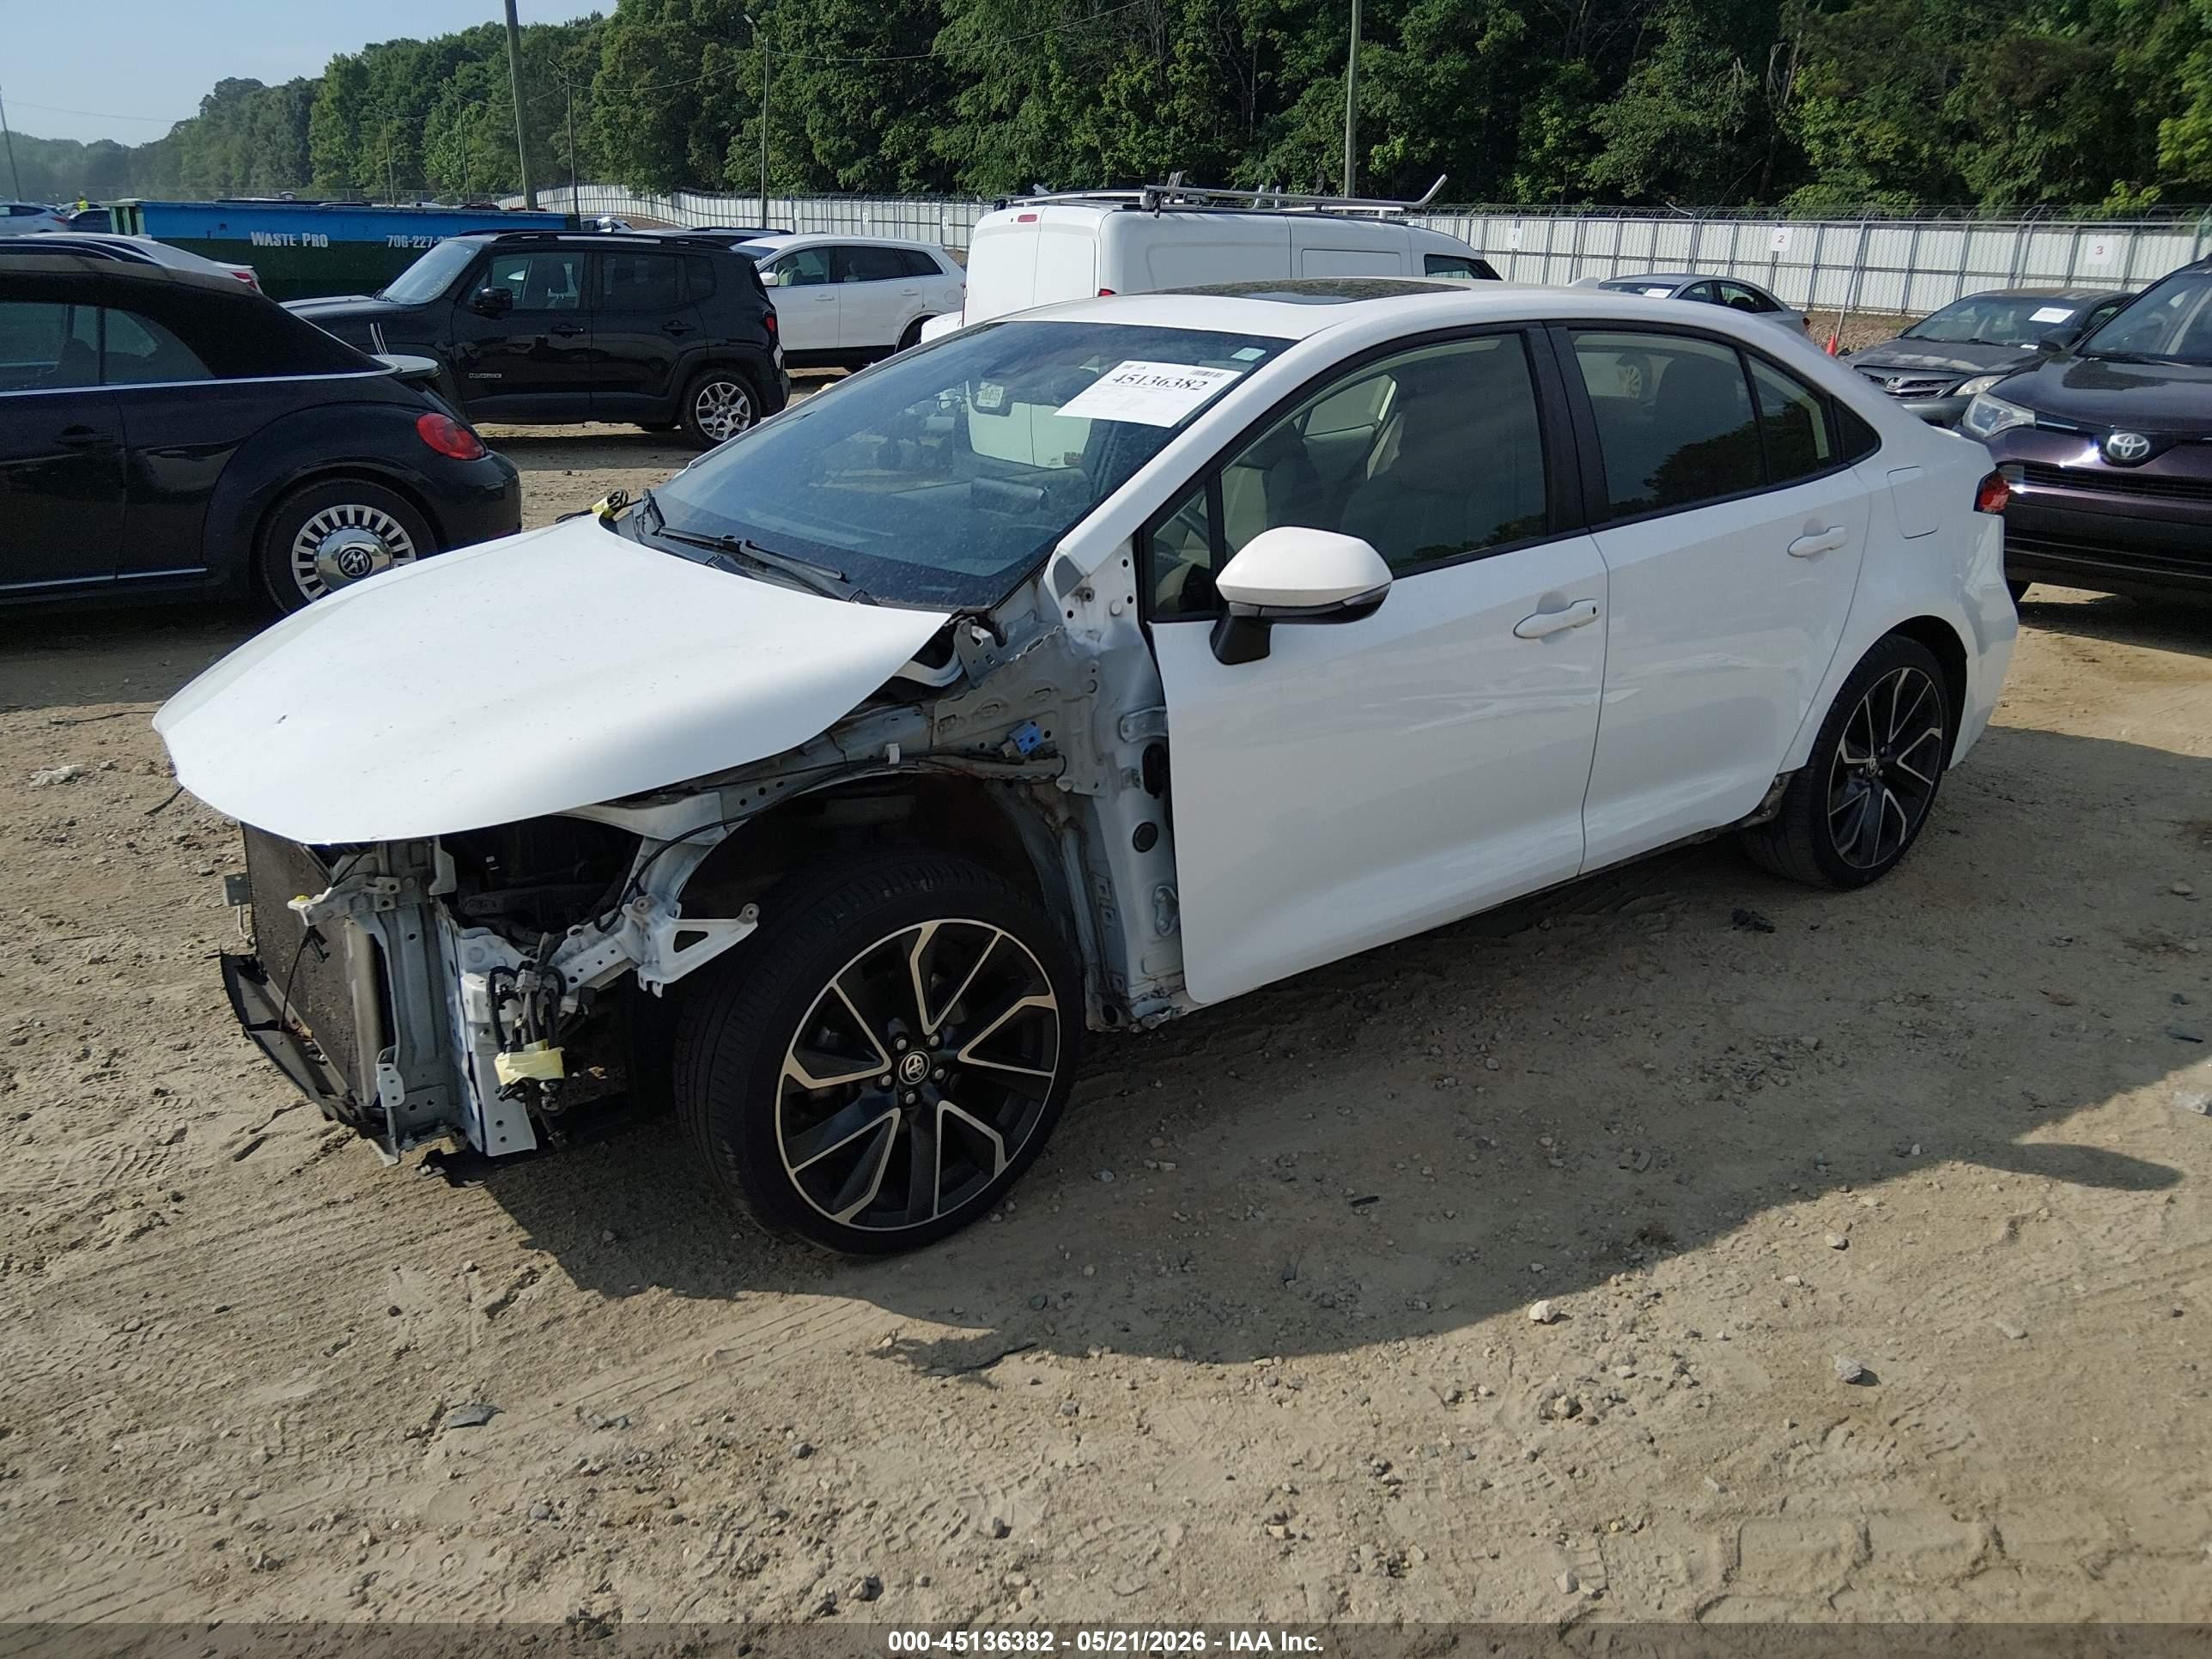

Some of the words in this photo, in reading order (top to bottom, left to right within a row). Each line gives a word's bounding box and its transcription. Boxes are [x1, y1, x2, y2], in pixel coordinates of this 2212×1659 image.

[251, 231, 297, 247] WASTE
[301, 232, 329, 248] PRO
[1778, 234, 1786, 243] 2
[2095, 246, 2104, 255] 3
[1113, 374, 1208, 391] 45136382
